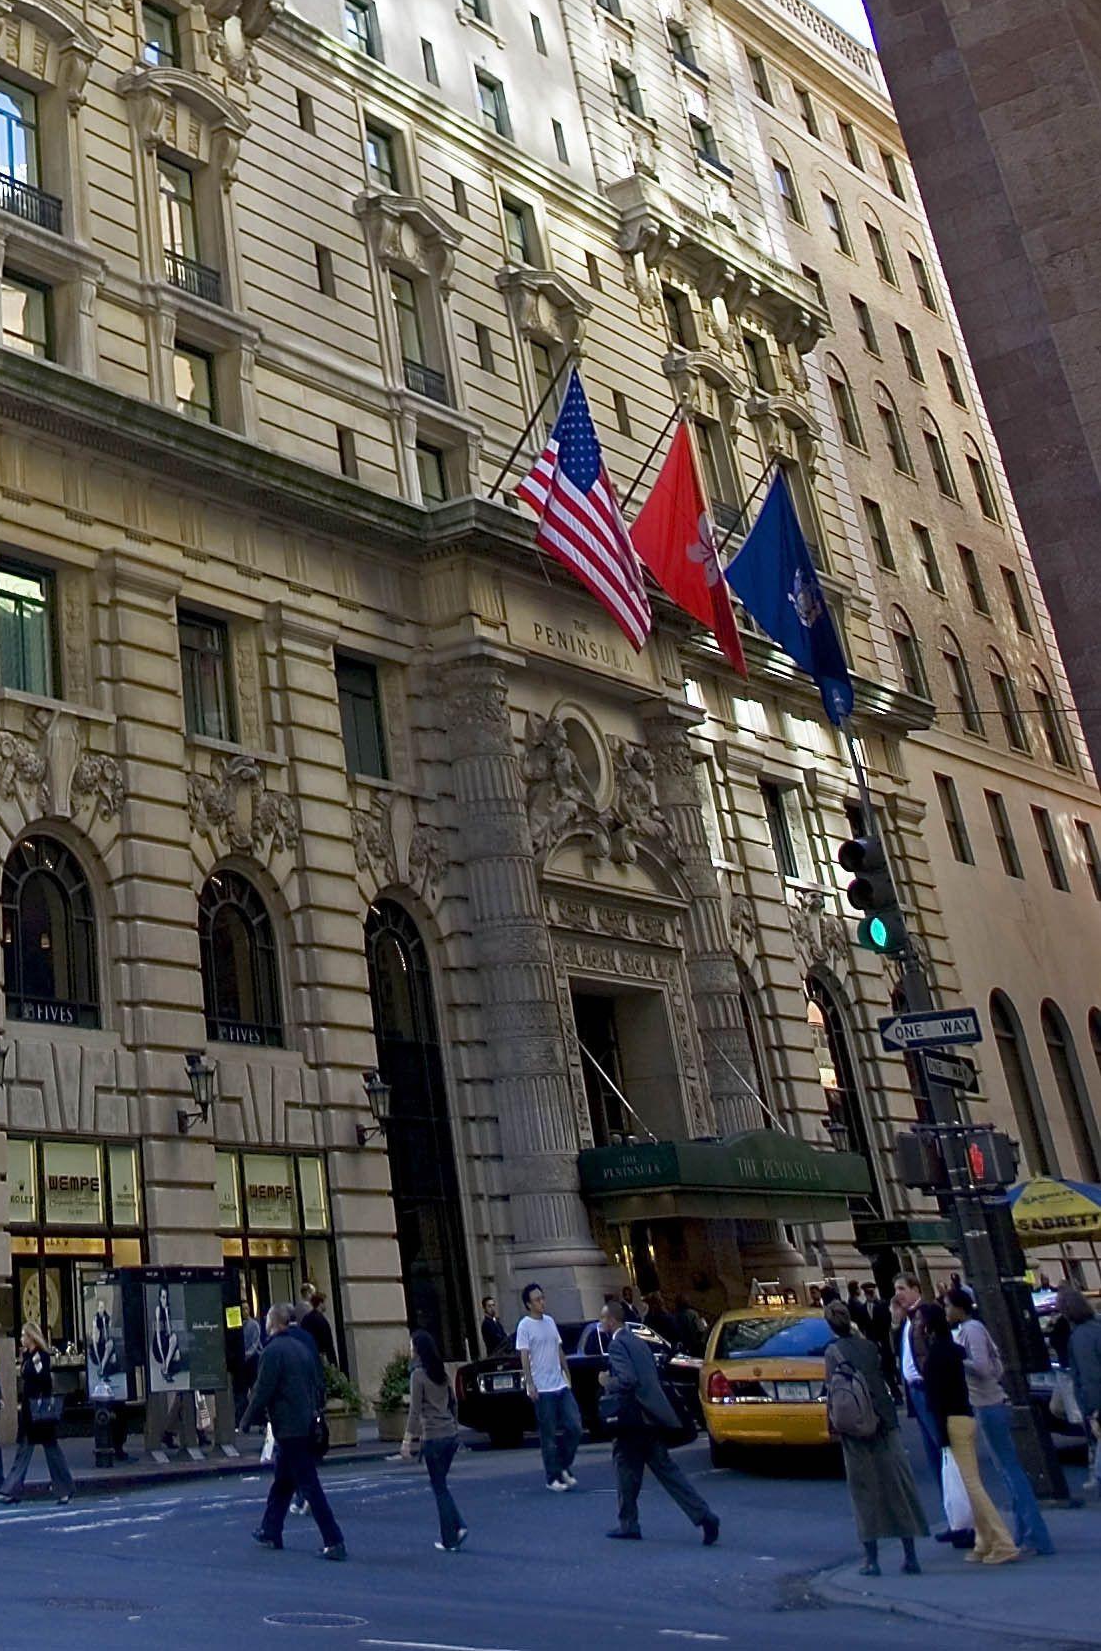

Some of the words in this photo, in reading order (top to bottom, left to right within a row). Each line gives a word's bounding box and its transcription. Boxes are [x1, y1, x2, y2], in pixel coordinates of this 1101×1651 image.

[533, 622, 634, 673] PENINSULA
[36, 1003, 74, 1024] FIVES
[894, 1024, 925, 1040] ONE
[940, 1018, 972, 1036] WAY
[737, 1157, 758, 1178] THE
[762, 1157, 822, 1181] PENINSULA
[48, 1175, 100, 1192] WEMPE
[248, 1184, 293, 1200] WEMPE
[1017, 1213, 1100, 1231] SABRETT
